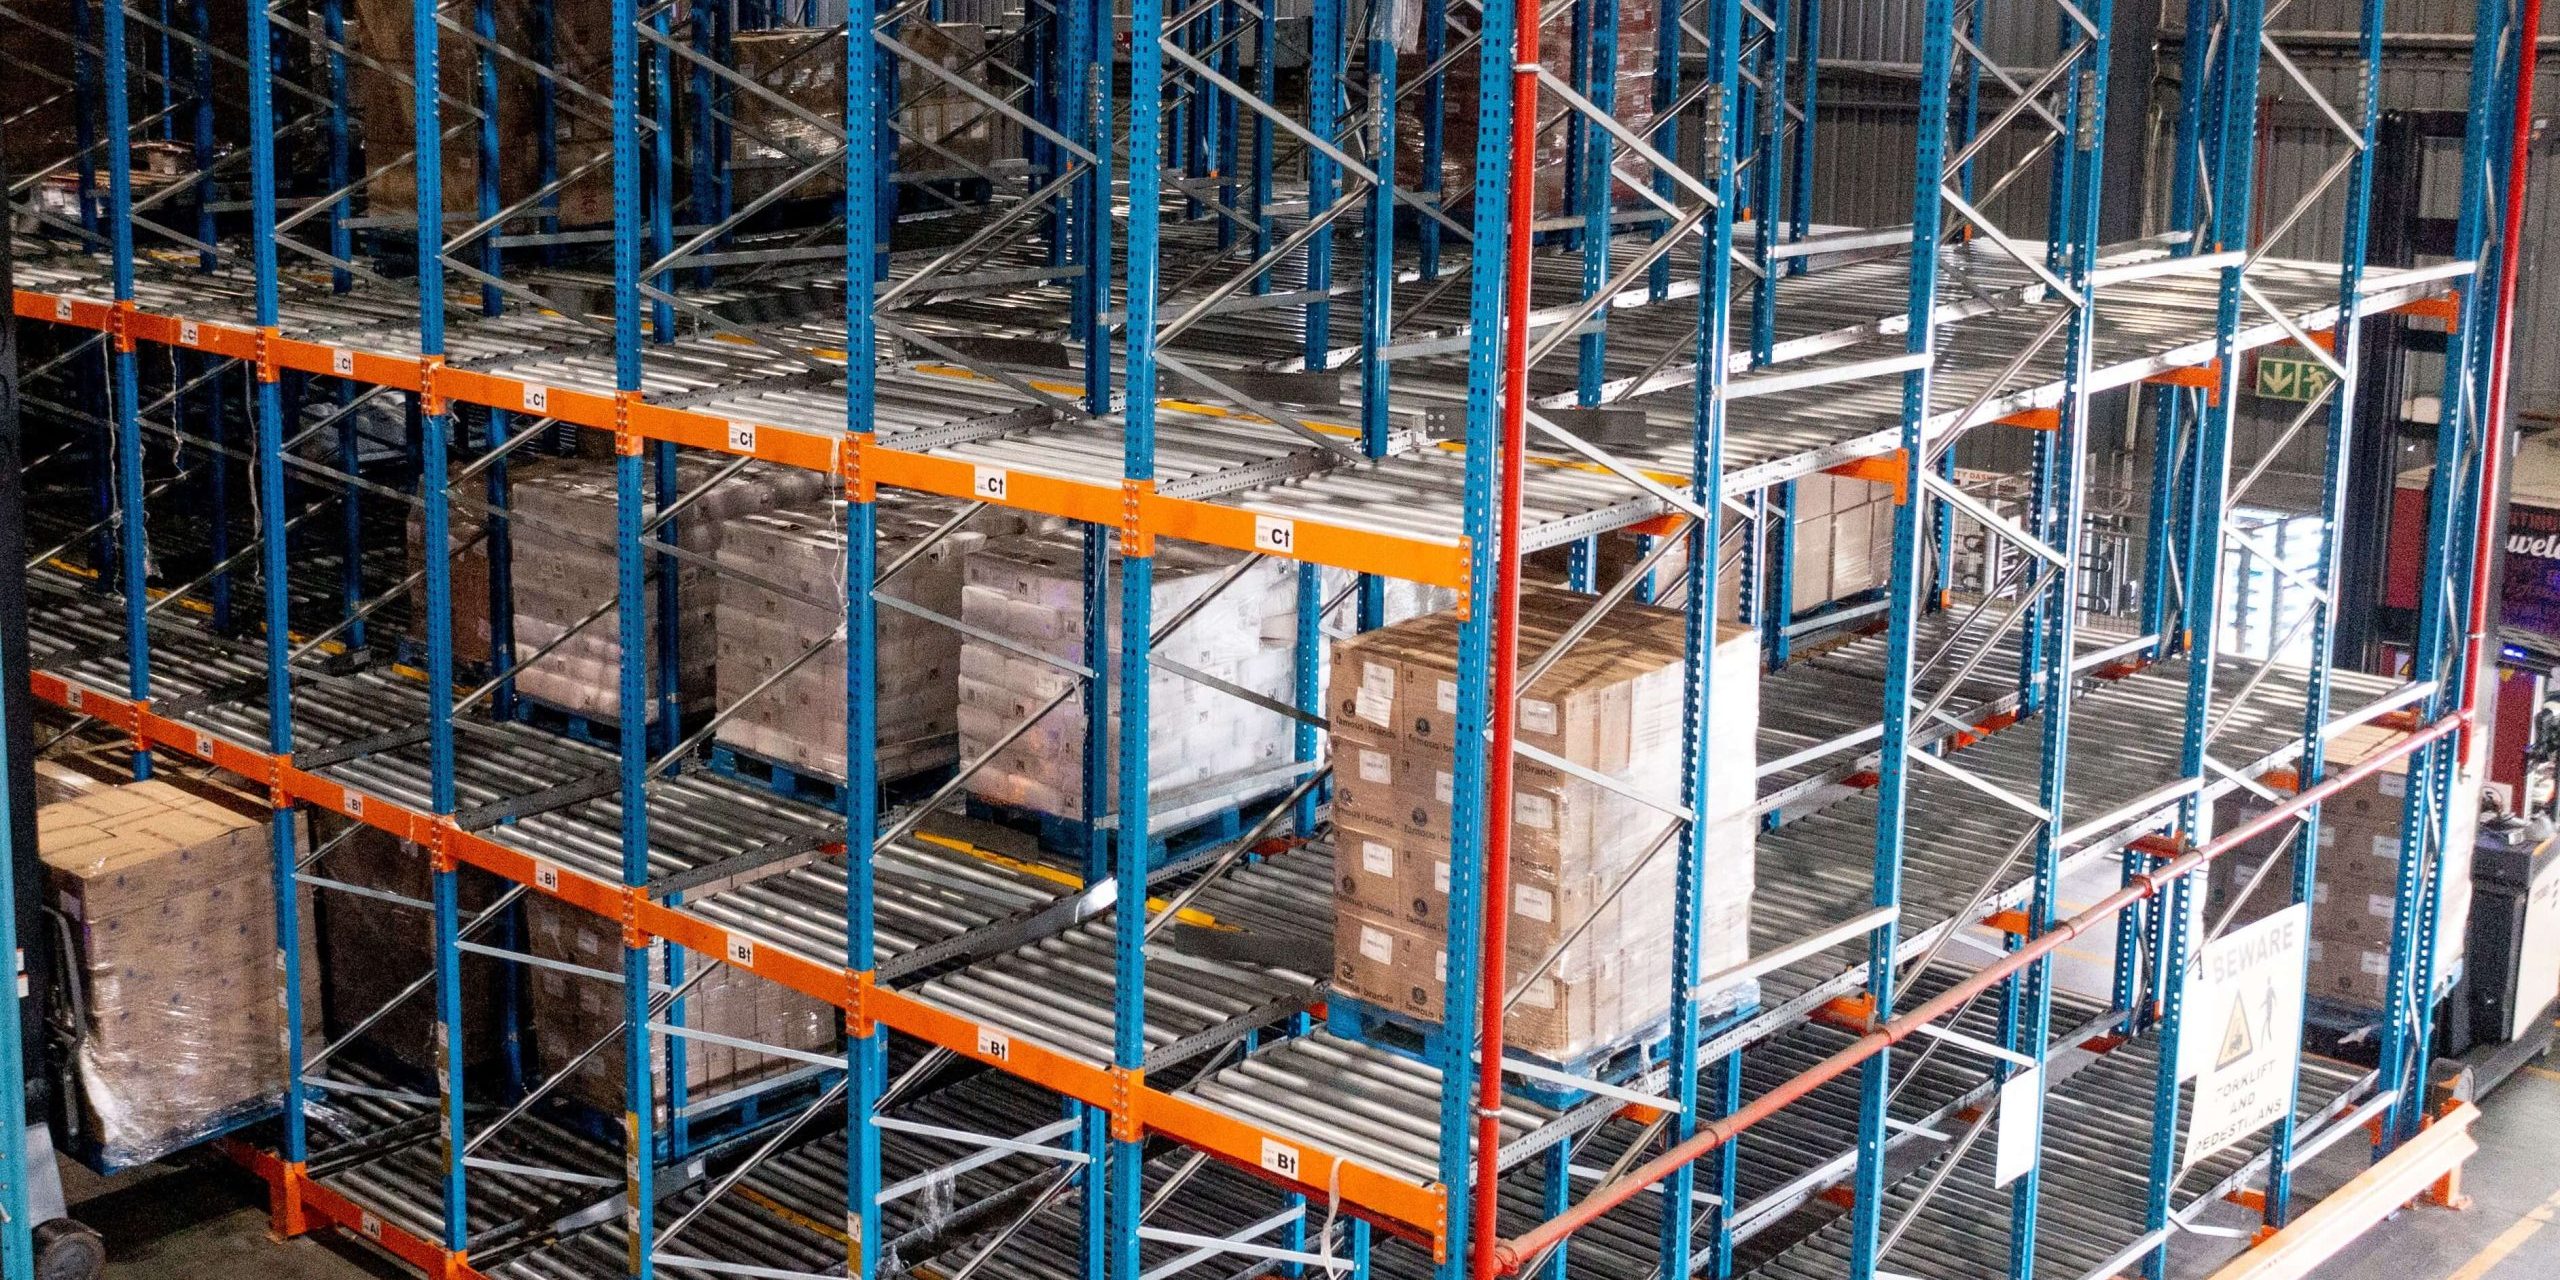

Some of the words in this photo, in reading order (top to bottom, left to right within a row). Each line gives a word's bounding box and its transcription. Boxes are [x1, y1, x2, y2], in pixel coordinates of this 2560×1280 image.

[1336, 716, 1364, 731] famous
[2213, 921, 2294, 984] BEWARE
[1363, 990, 1394, 1003] brands
[2229, 1091, 2256, 1115] AND
[2193, 1098, 2283, 1156] PEDESTANS
